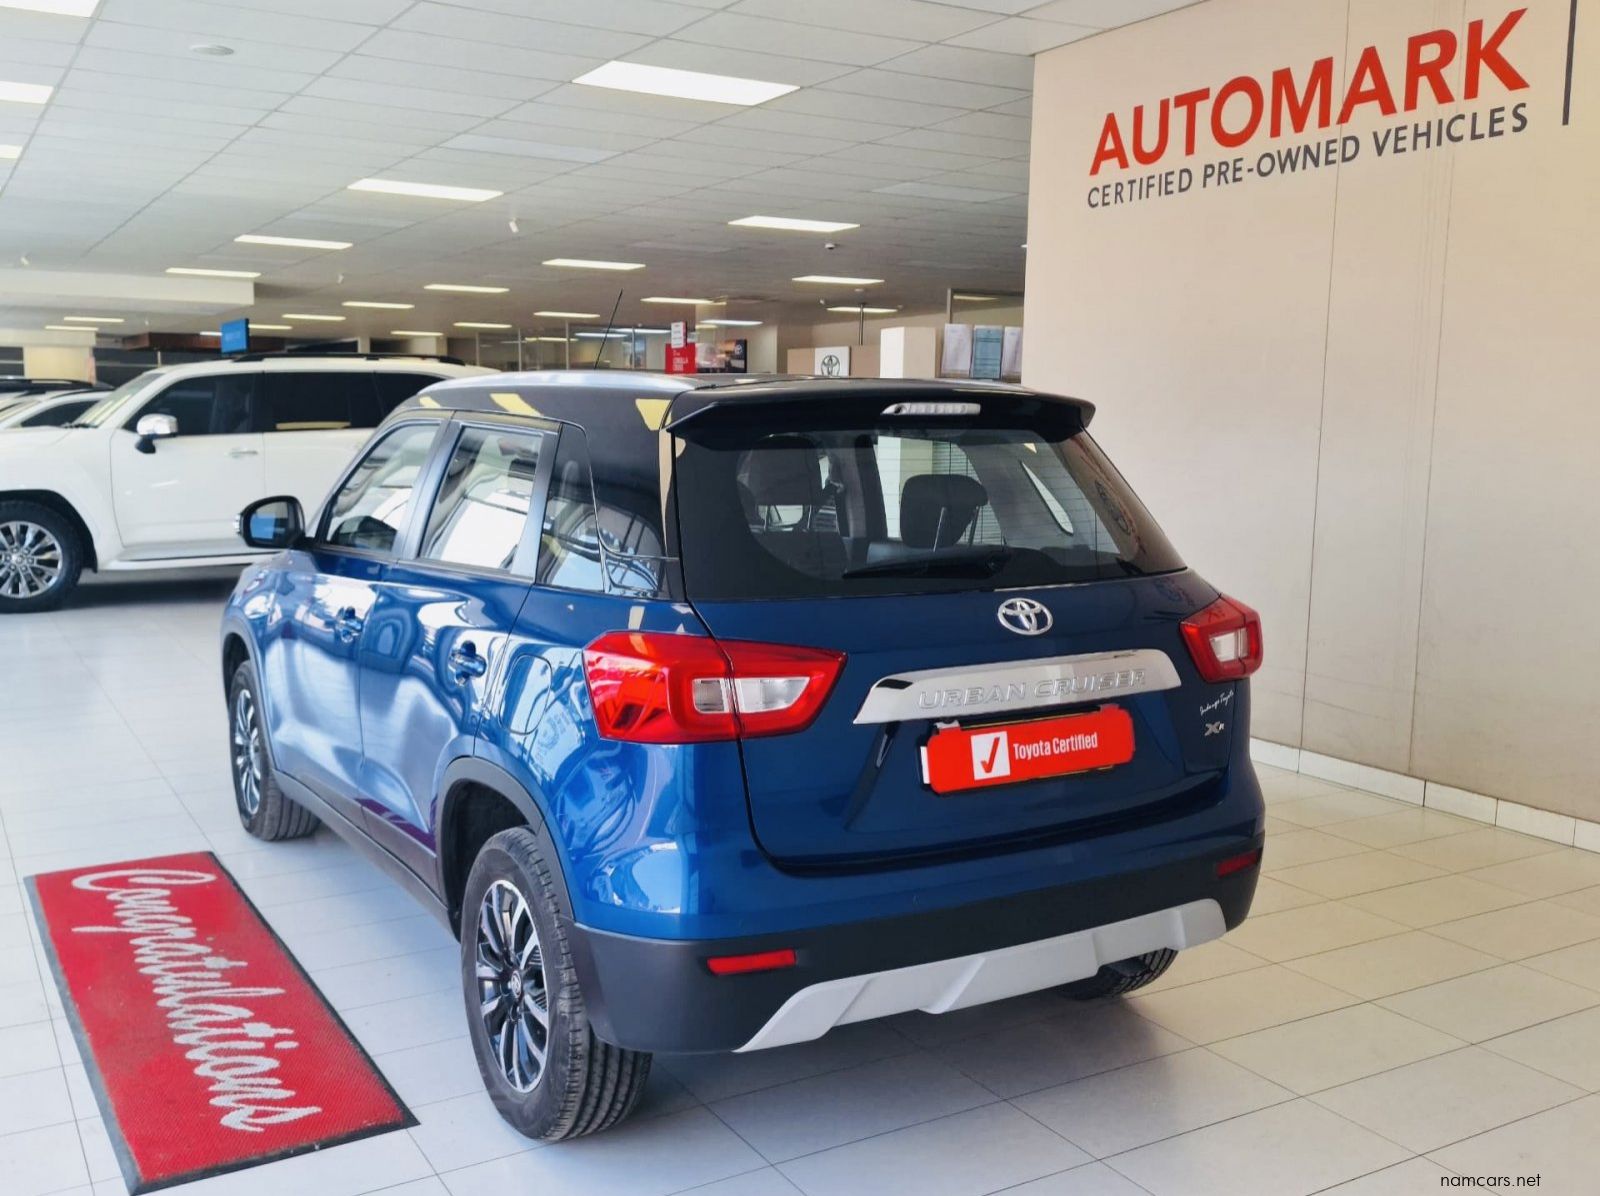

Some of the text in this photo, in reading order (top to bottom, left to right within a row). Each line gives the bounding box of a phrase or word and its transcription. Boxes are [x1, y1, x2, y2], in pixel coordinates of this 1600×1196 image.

[1089, 7, 1530, 176] AUTOMARK
[1087, 102, 1528, 208] CERTIFIED PRE-OWNED VEHICLES
[918, 668, 1146, 710] URBAN CRUISER
[1012, 732, 1098, 760] Toyota Certified
[71, 869, 322, 1132] Congratulations
